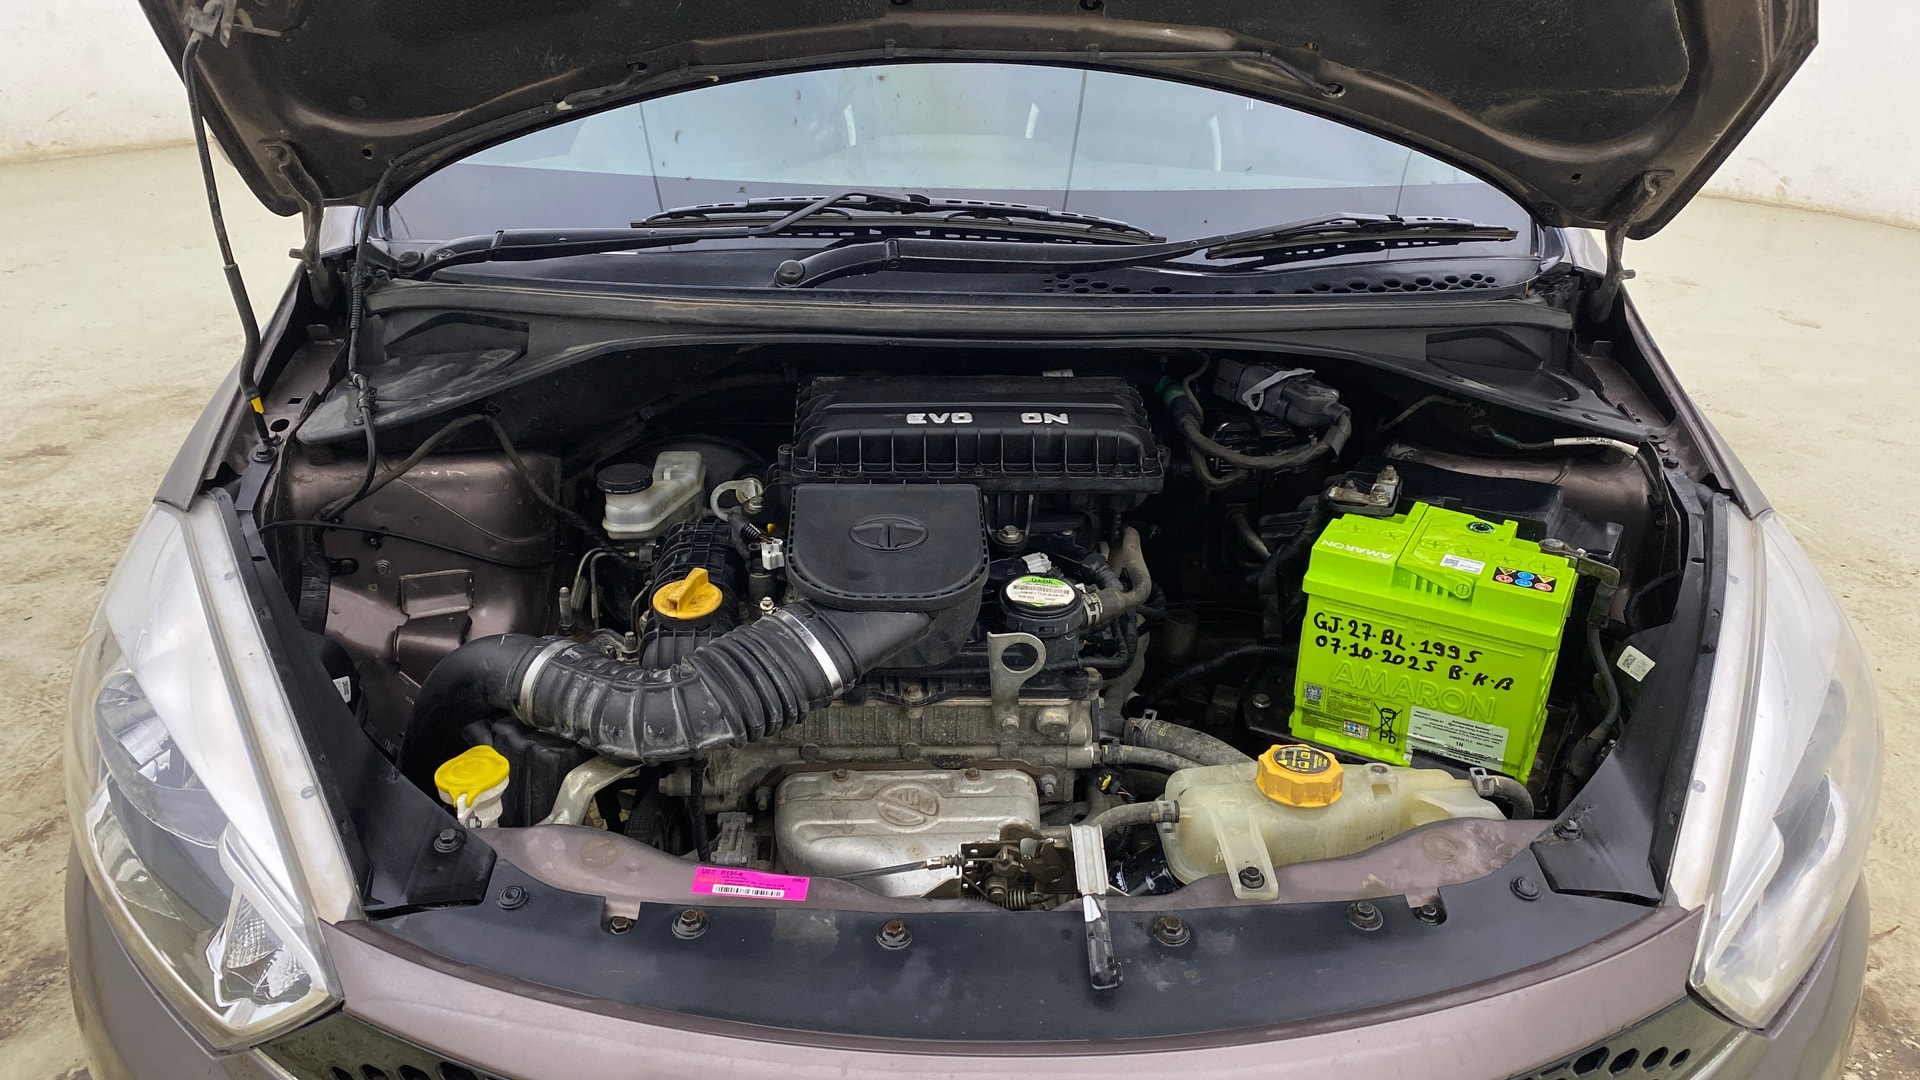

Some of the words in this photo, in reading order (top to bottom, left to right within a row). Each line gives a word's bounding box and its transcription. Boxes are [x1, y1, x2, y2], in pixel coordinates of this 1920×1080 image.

[1020, 412, 1069, 424] ON
[1320, 538, 1395, 560] AMARON
[1331, 659, 1496, 723] AMARON
[1379, 731, 1397, 745] Pb
